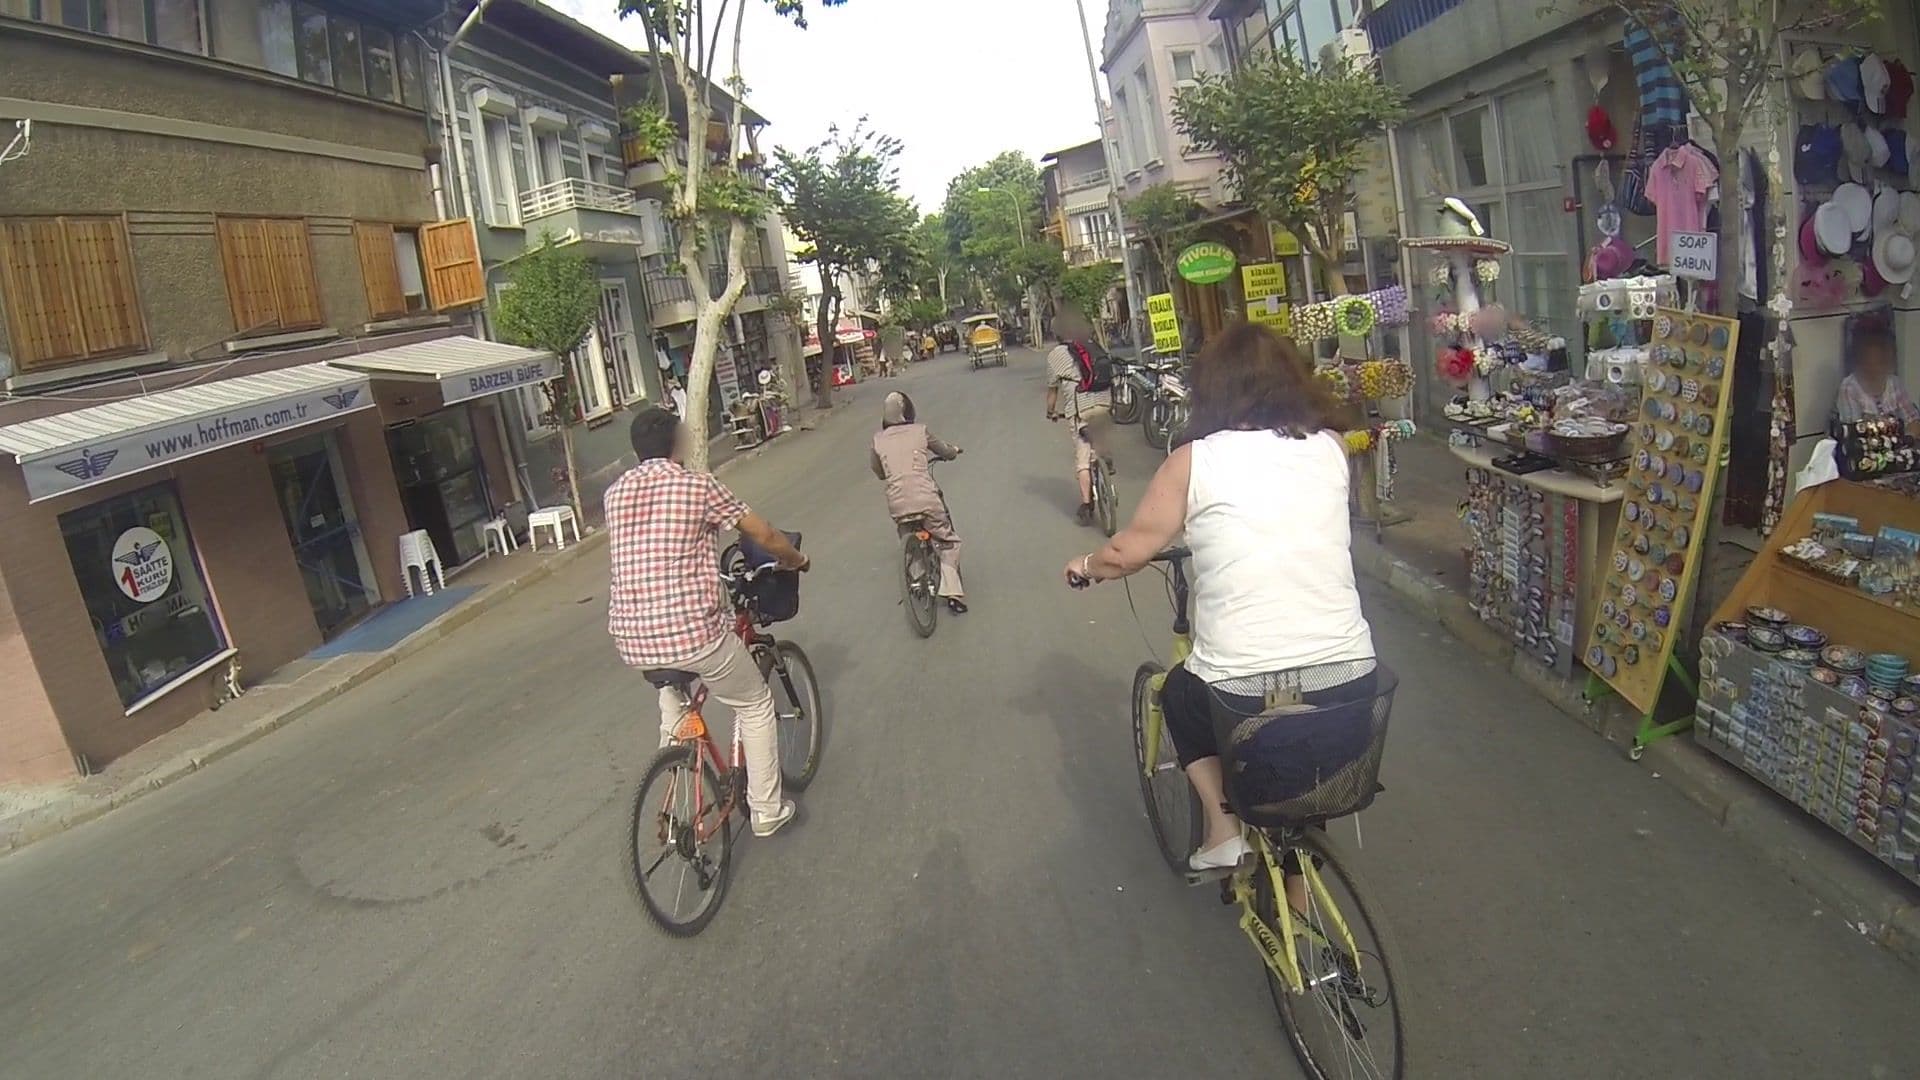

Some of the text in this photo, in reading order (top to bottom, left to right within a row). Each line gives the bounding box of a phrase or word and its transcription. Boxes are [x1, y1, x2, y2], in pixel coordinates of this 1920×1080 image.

[1679, 236, 1708, 249] SOAP
[1180, 246, 1235, 267] TIVOLI'S
[1674, 256, 1712, 271] SABUN
[469, 363, 544, 393] BARZEN BÜFE
[145, 403, 307, 459] www.hoffman.com.tr
[133, 556, 169, 579] SAATTE
[137, 569, 168, 588] KURU
[121, 566, 139, 598] 1
